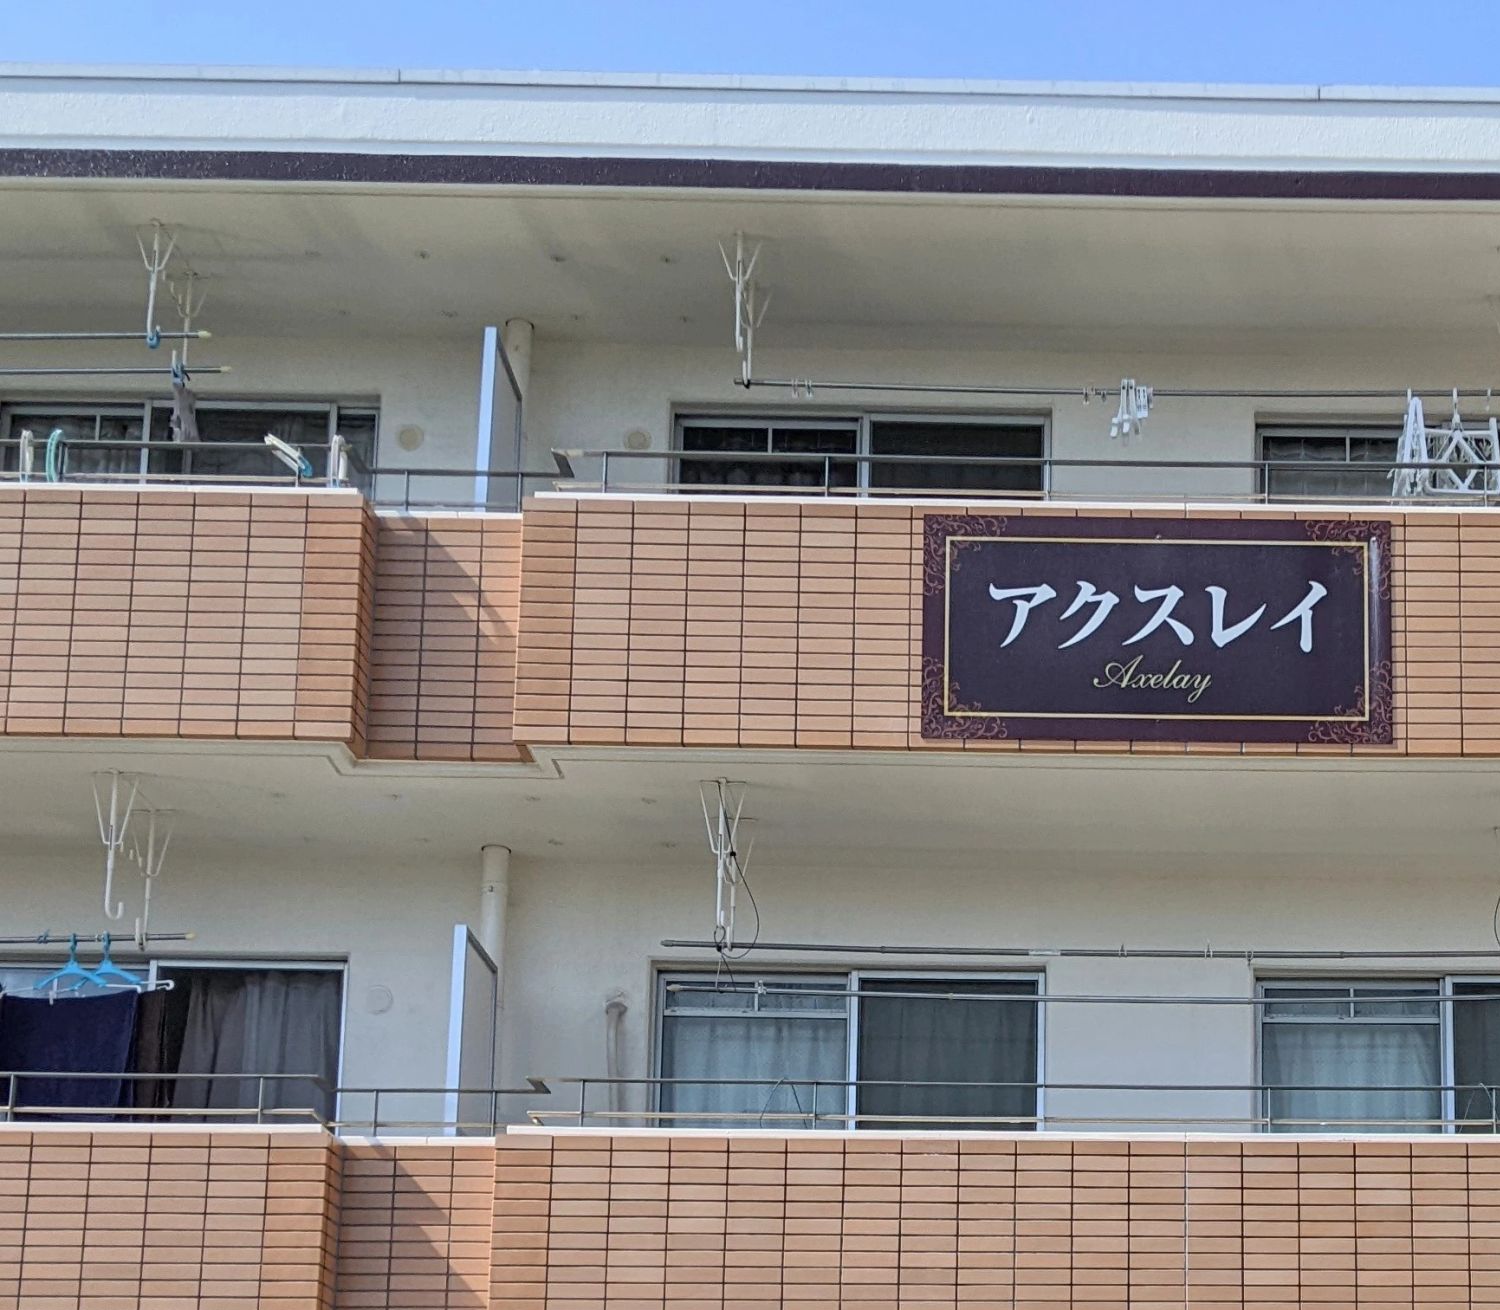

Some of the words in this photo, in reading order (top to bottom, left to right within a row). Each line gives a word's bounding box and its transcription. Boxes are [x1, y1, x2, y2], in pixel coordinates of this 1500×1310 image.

[988, 580, 1328, 653] アクスレイ
[1093, 654, 1212, 702] Axelay
